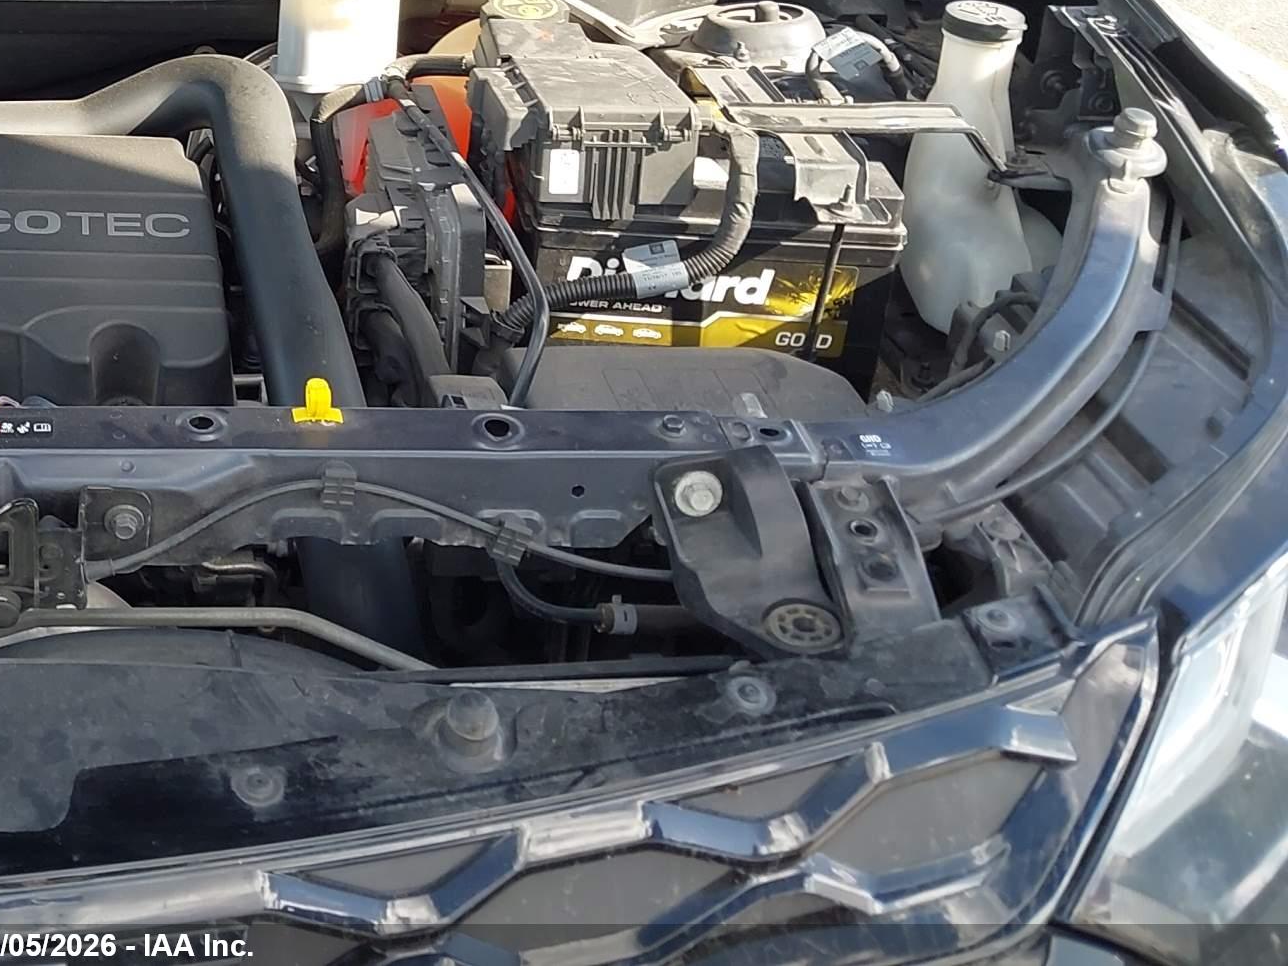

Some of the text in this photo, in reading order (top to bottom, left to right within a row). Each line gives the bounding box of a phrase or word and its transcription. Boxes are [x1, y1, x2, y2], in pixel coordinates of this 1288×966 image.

[566, 255, 775, 305] Diard
[612, 301, 663, 313] AHEAD
[775, 331, 833, 349] GOD
